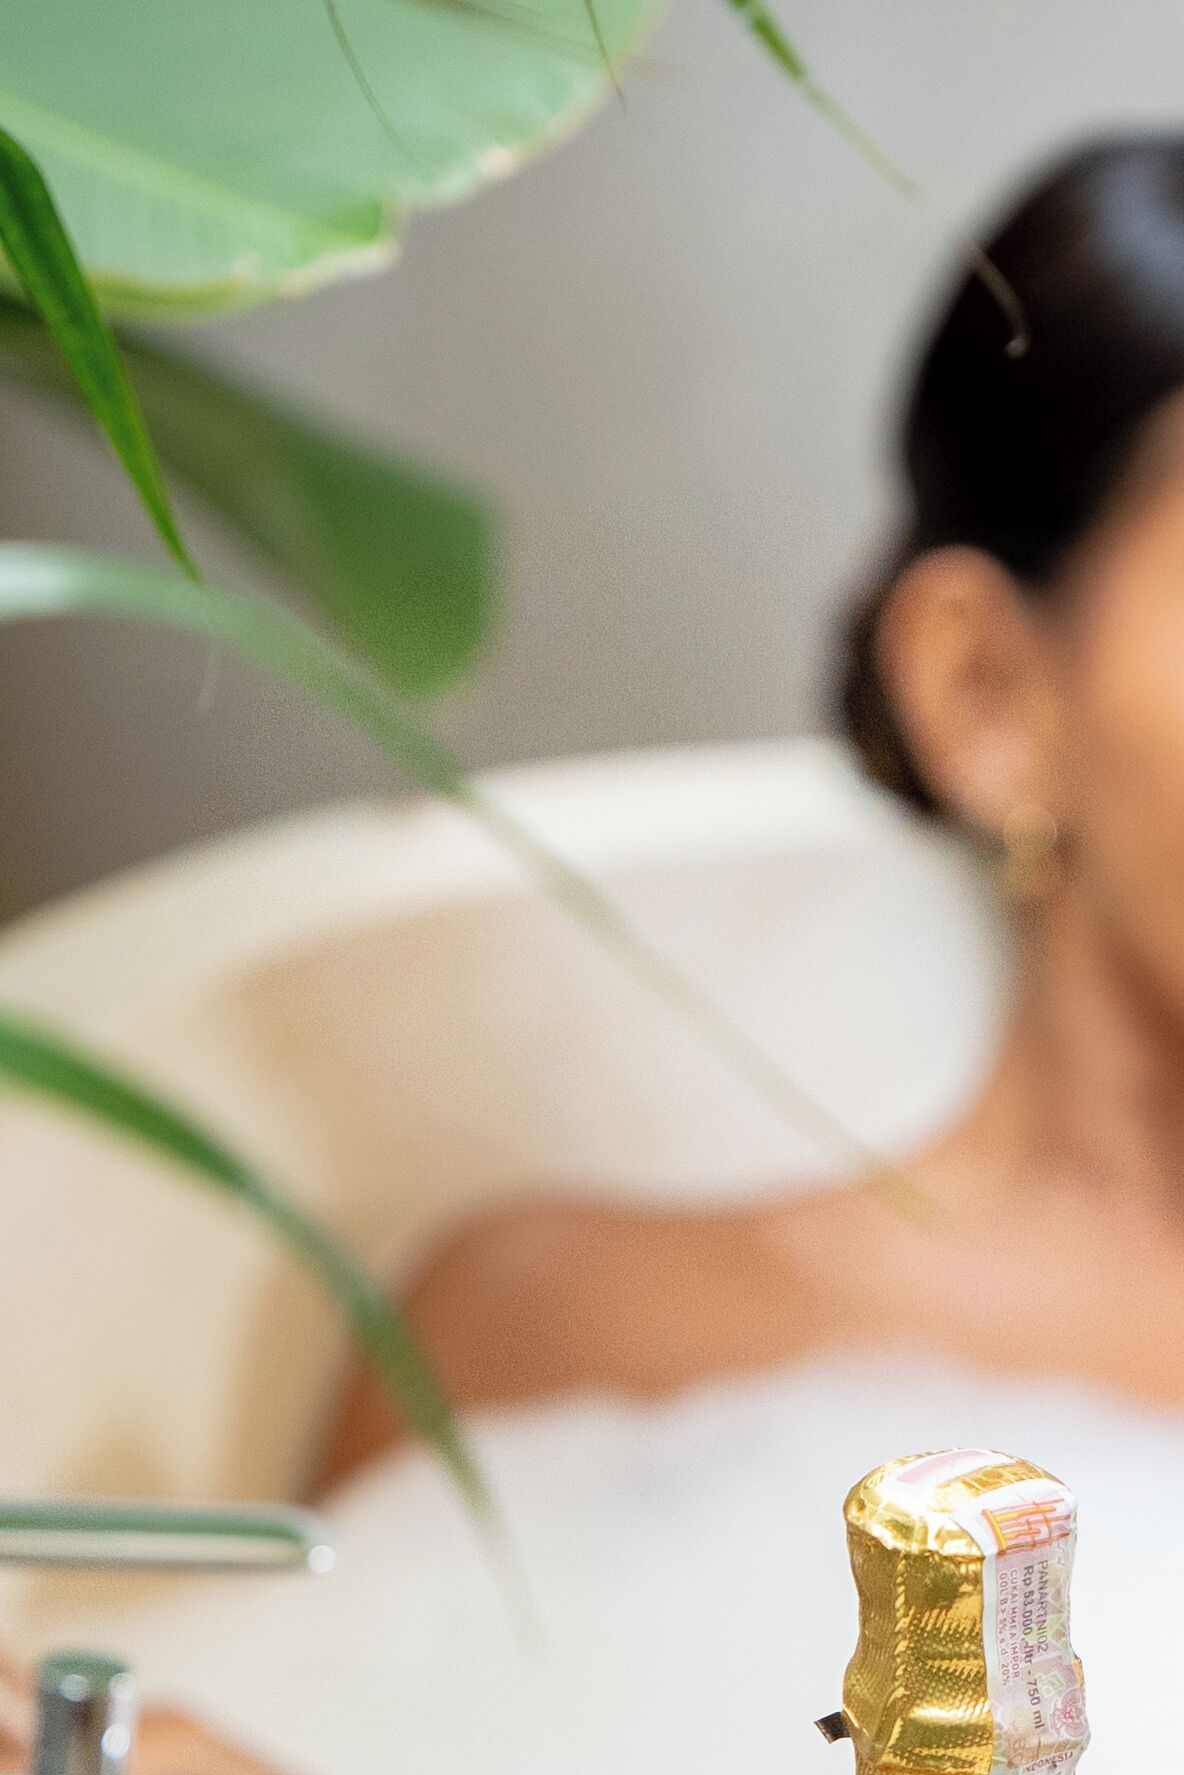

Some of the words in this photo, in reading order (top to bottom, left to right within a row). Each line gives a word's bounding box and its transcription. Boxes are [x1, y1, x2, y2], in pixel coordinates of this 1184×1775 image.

[1010, 1569, 1018, 1603] CUKAI
[1022, 1565, 1034, 1587] Rp
[1010, 1641, 1020, 1679] IMPOR
[1001, 1662, 1010, 1686] 20%
[1027, 1678, 1041, 1706] 750
[1033, 1710, 1045, 1729] ml
